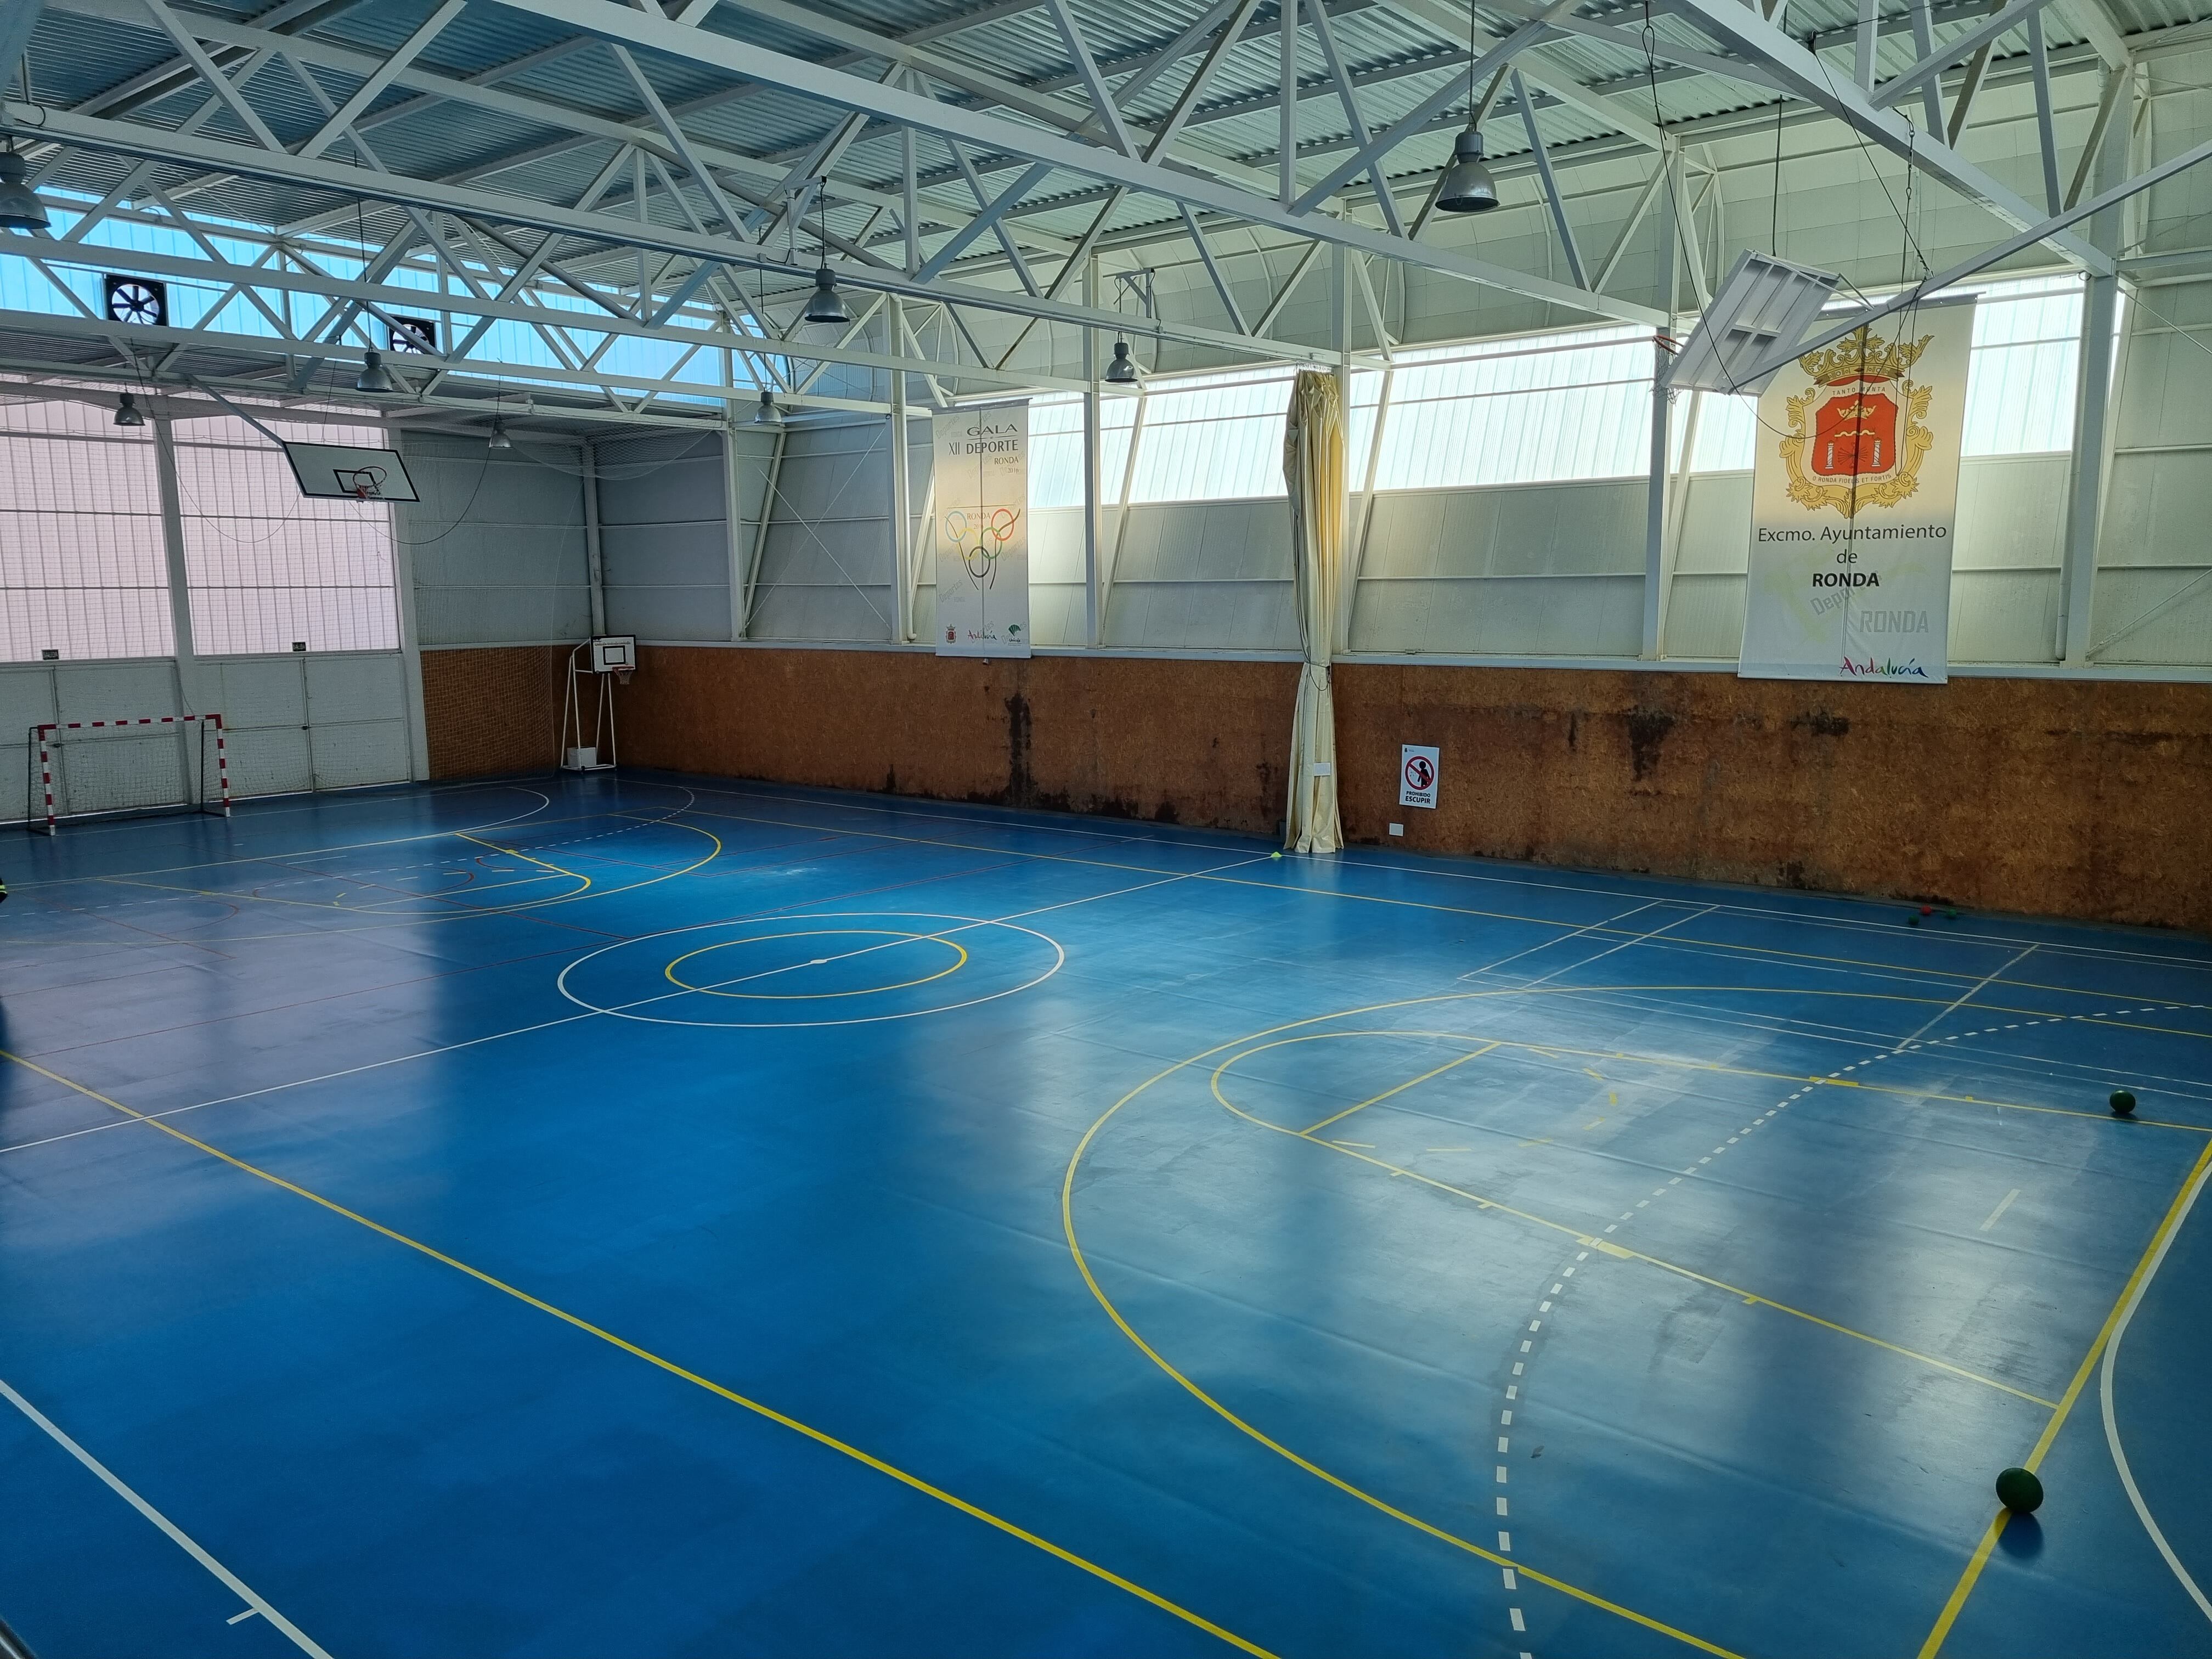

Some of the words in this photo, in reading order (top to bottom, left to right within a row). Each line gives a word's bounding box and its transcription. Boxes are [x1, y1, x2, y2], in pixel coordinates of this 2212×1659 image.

[1833, 387, 1855, 396] TANTO
[935, 415, 961, 439] Deportes
[967, 424, 1018, 436] GALA
[949, 442, 960, 456] XII
[966, 439, 1019, 455] DEPORTE
[994, 456, 1019, 465] RONDA
[1870, 473, 1892, 482] FORTIS
[1758, 528, 1815, 542] Excmo.
[1820, 524, 1947, 544] Ayuntamiento
[1836, 549, 1858, 564] de
[1812, 573, 1880, 587] RONDA
[939, 579, 963, 602] Deportes
[1859, 610, 1929, 633] RONDA
[1839, 656, 1929, 678] Andalucía
[1405, 795, 1431, 804] ESCUPIR
